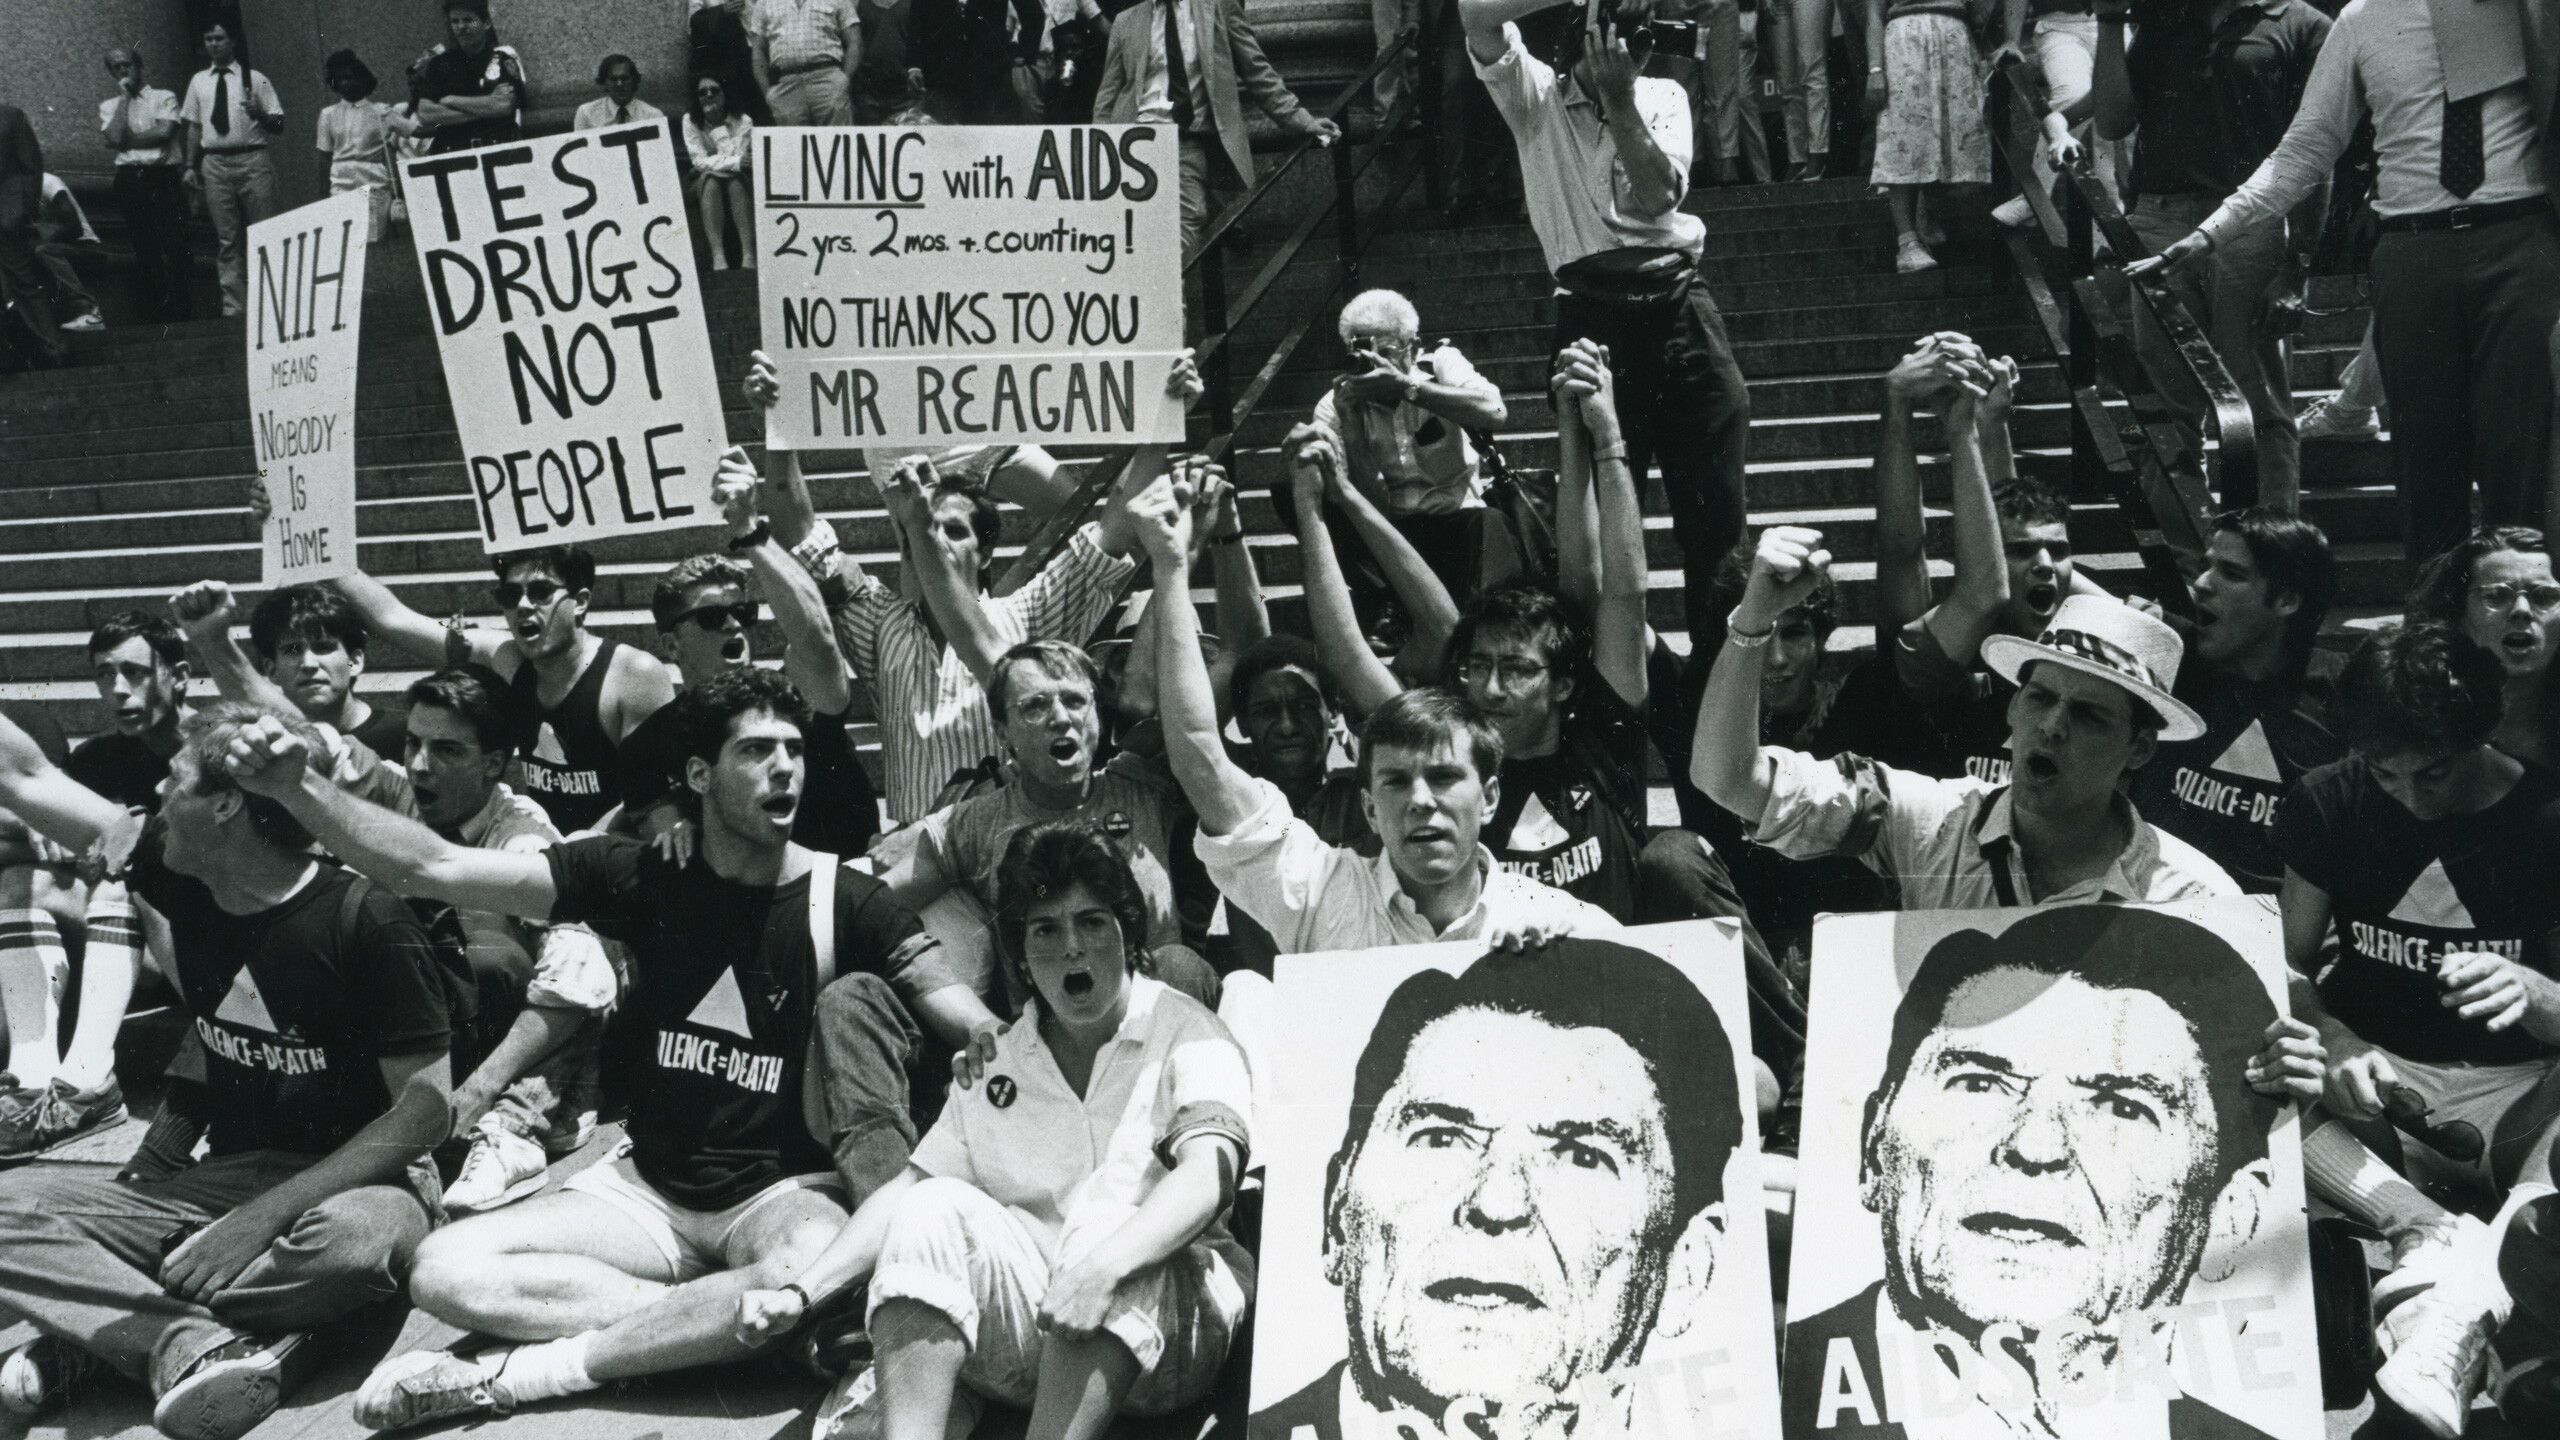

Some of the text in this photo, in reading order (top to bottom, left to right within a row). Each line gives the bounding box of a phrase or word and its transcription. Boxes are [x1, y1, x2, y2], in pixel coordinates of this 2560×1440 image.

[407, 125, 660, 242] TEST
[763, 127, 1159, 203] LIVING with AIDS
[425, 215, 682, 336] DRUGS
[774, 212, 807, 257] 2
[812, 234, 856, 276] yrs.
[869, 210, 900, 257] 2
[904, 234, 949, 254] mos.
[783, 291, 1139, 348] NO THANKS TO YOU
[270, 354, 318, 390] MEANS
[503, 305, 680, 425] NOT
[810, 360, 1134, 437] MR REAGAN
[258, 410, 336, 462] NOBODY
[471, 423, 695, 542] PEOPLE
[279, 517, 332, 569] HOME
[2171, 767, 2284, 826] SILENCE=DE
[657, 1030, 784, 1094] ILENCE=DEATH
[1816, 1295, 2299, 1429] AIDSGATE
